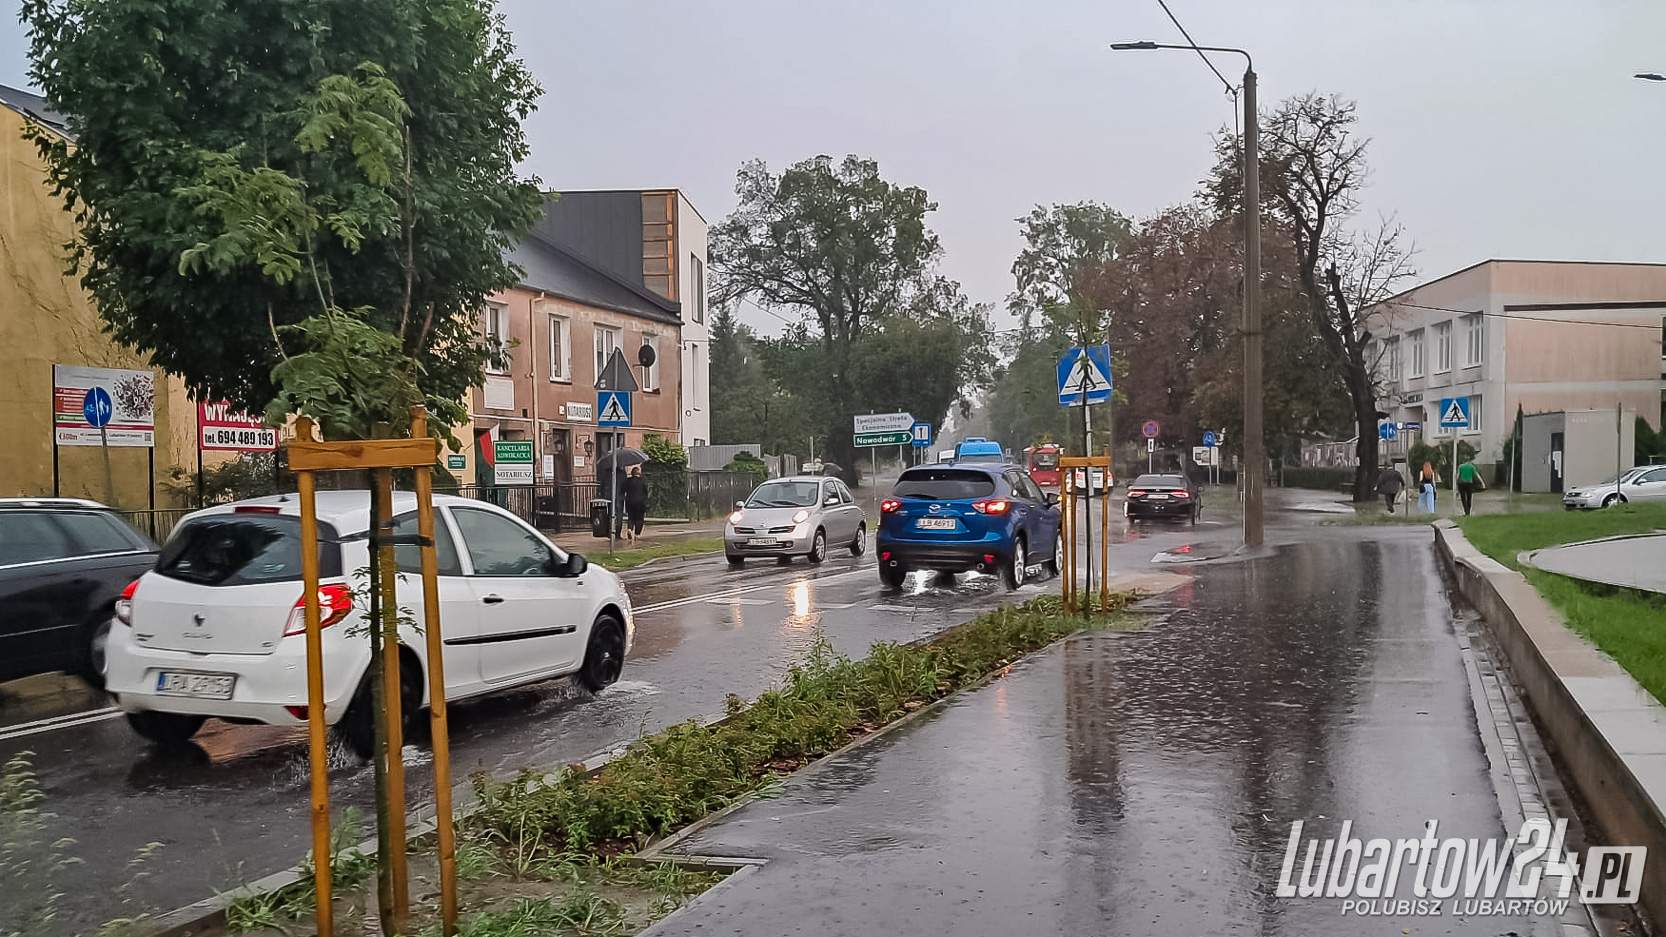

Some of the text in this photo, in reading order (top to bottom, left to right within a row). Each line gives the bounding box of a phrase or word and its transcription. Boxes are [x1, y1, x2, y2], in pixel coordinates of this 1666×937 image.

[205, 431, 274, 446] tel. 694 489 193
[856, 434, 908, 444] Nowodwór 5
